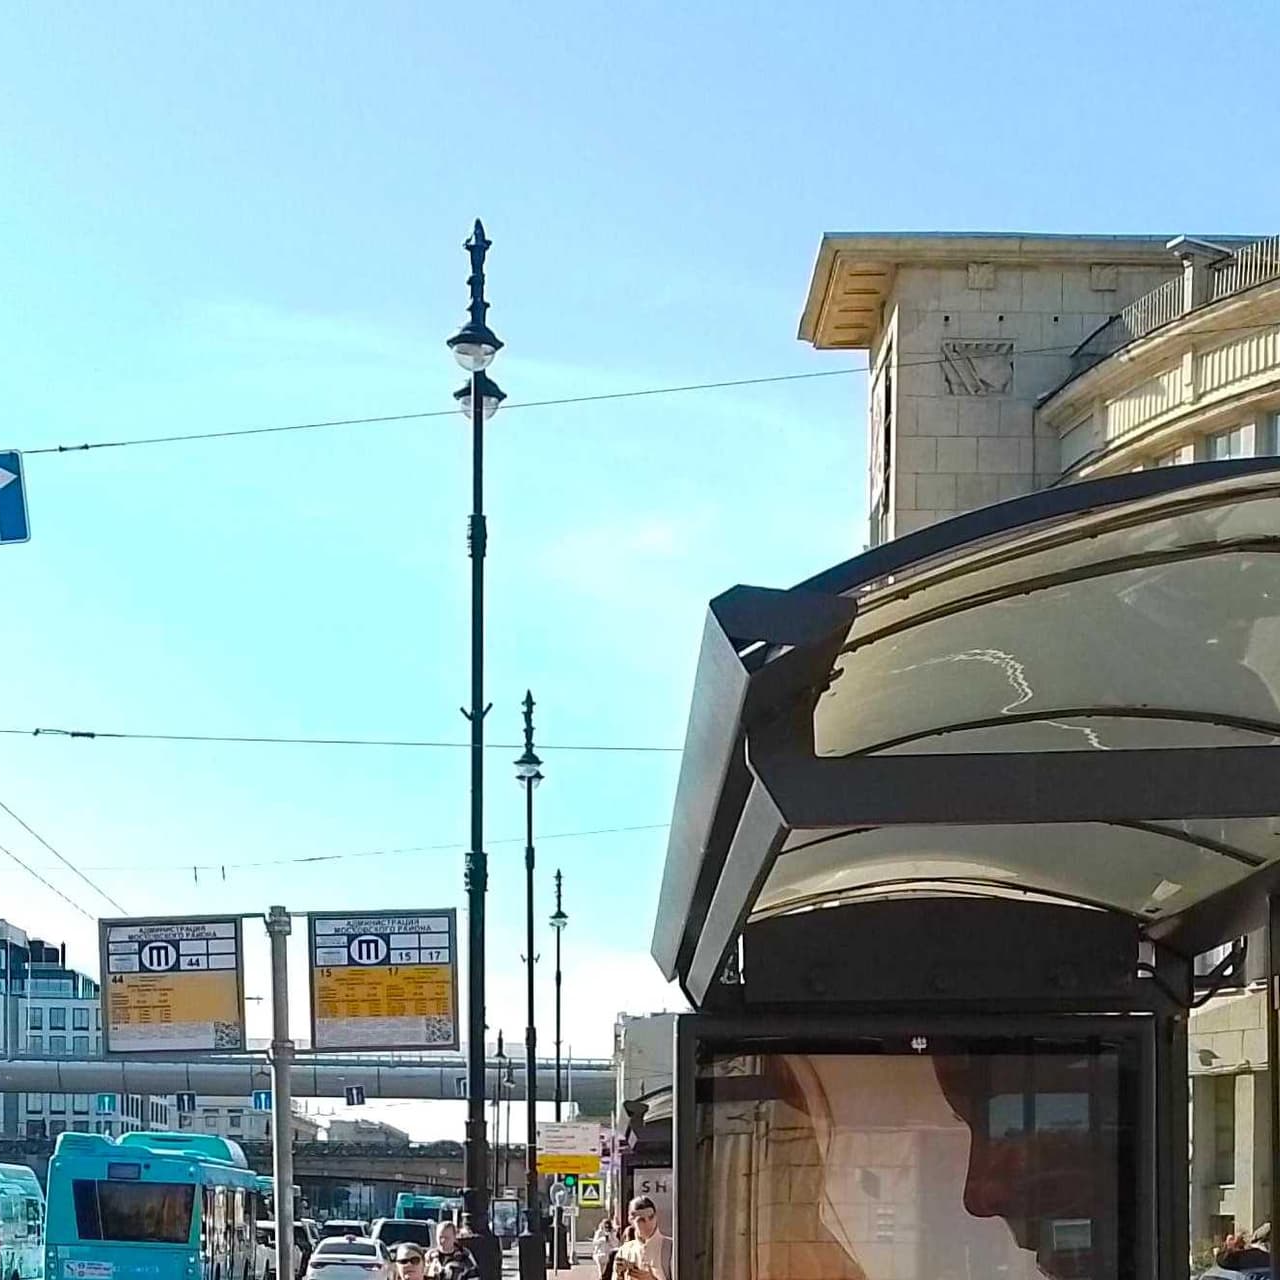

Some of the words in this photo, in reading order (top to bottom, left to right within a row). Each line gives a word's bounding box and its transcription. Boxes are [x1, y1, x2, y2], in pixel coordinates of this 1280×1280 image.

[398, 951, 412, 962] 15
[428, 950, 441, 961] 17
[187, 958, 200, 967] 44
[320, 968, 332, 978] 15
[111, 975, 124, 984] 44
